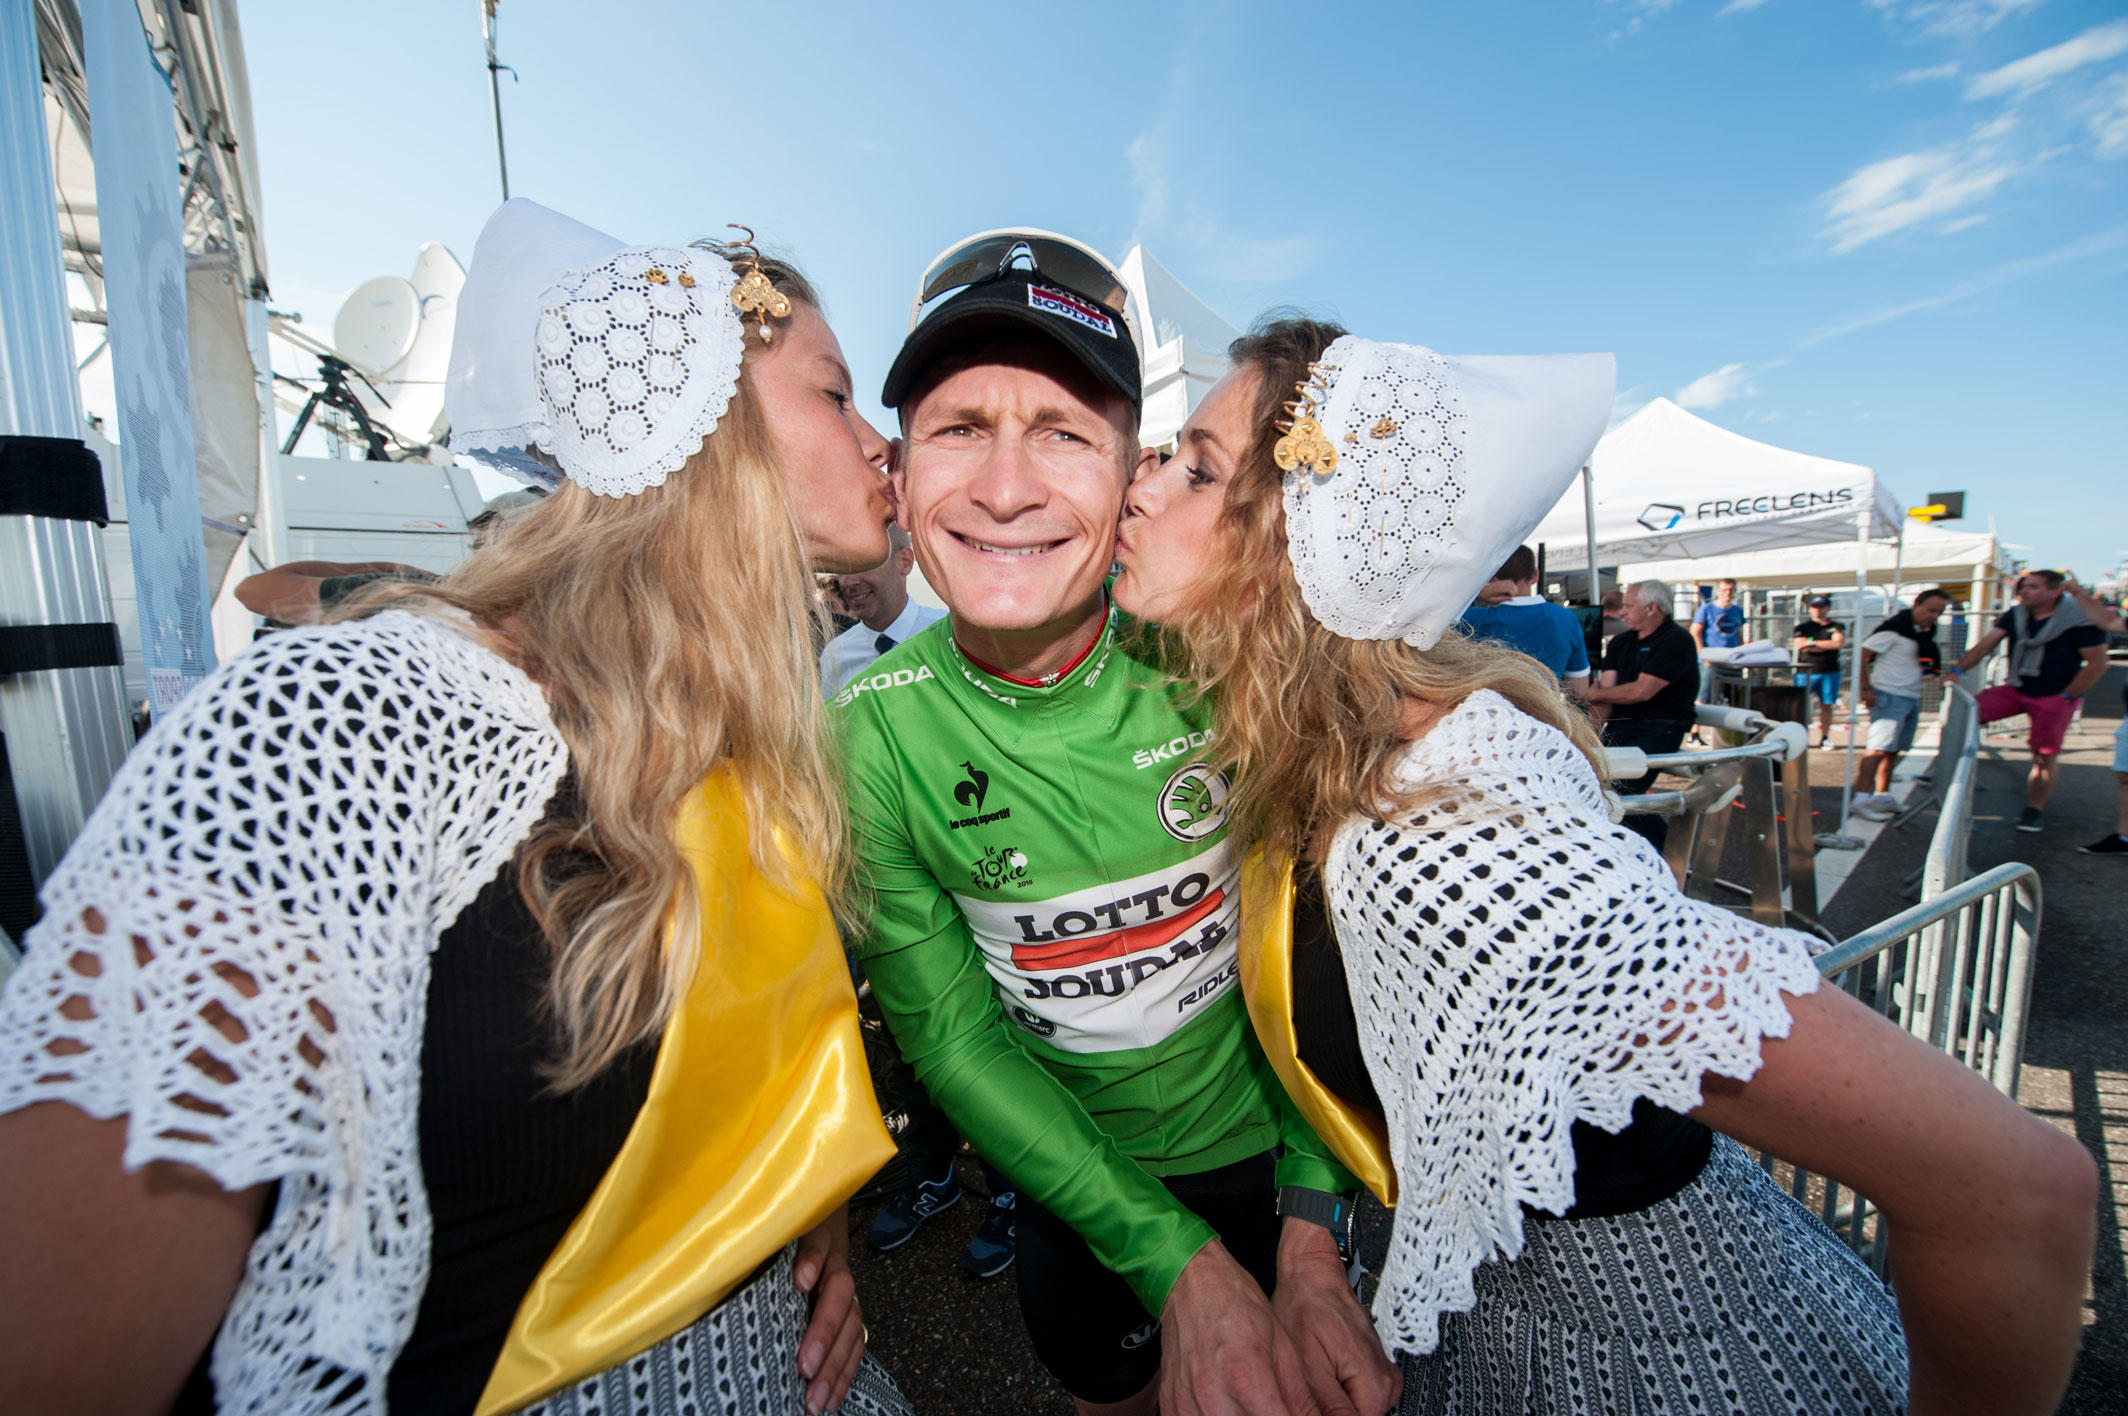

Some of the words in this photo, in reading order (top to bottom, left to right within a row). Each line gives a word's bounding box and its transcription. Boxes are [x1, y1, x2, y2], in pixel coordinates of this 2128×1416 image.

[1031, 295, 1113, 333] SOUDAL
[1697, 488, 1854, 520] FREELENS
[949, 819, 960, 830] le
[959, 816, 979, 827] coq
[977, 807, 1011, 825] sportif
[1016, 879, 1034, 889] 2015
[1013, 872, 1211, 943] LOTTO
[1178, 960, 1240, 1014] RIDLE
